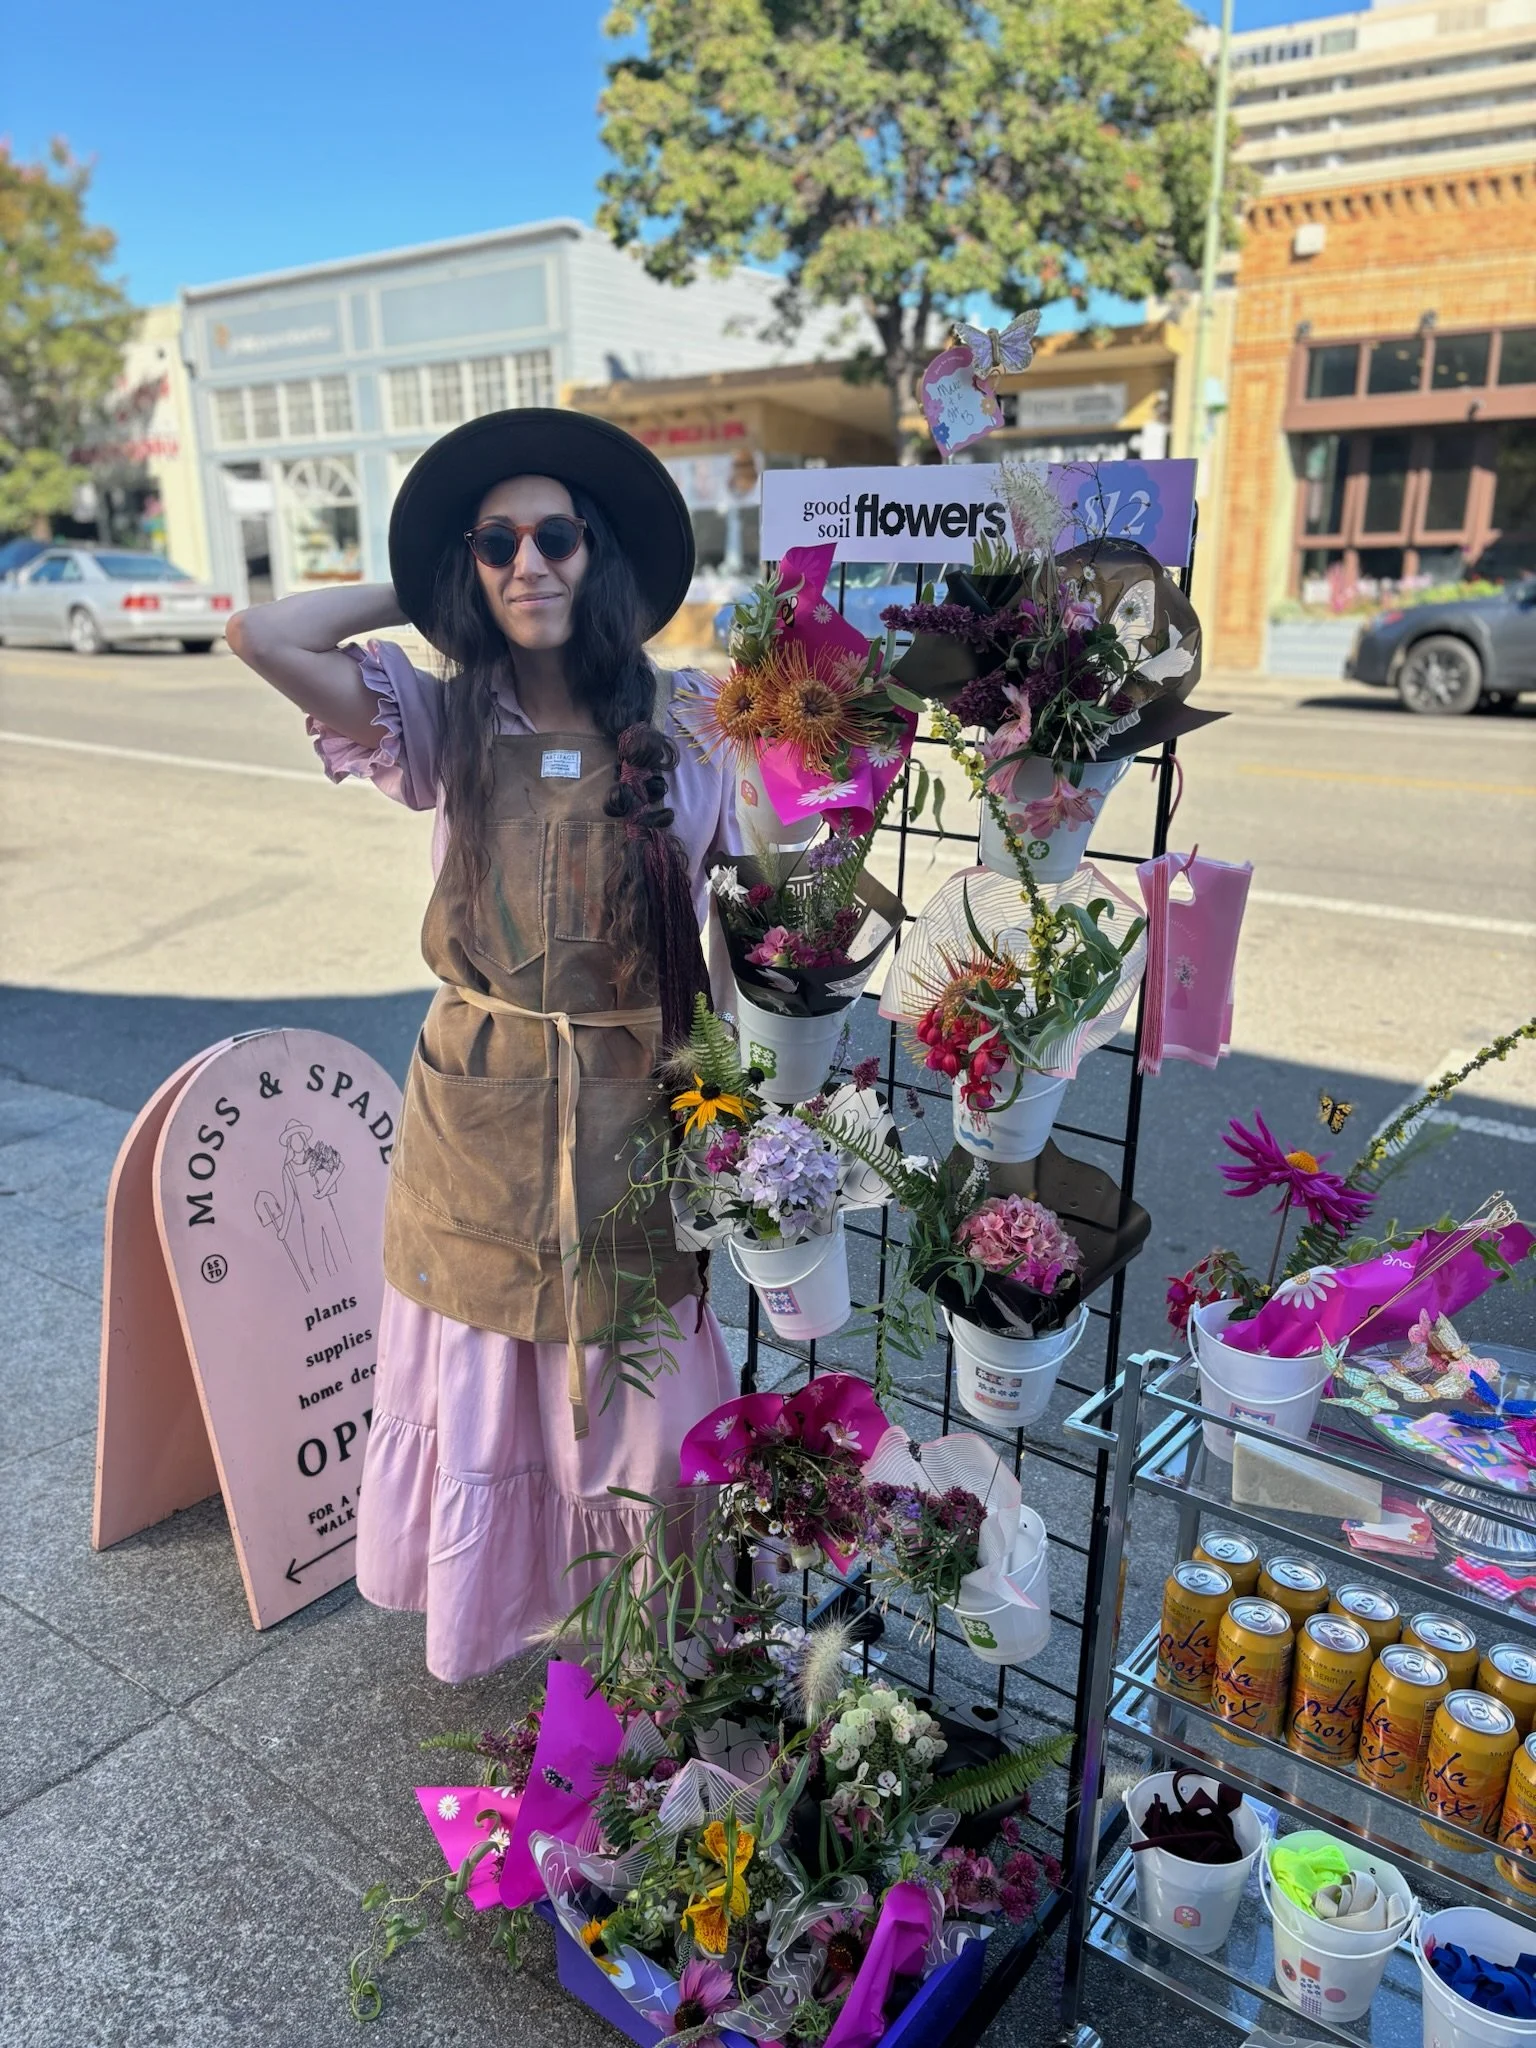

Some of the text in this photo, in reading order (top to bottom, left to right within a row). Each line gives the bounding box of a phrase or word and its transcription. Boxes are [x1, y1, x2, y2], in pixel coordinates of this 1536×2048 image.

[803, 493, 1006, 538] good flowers
[817, 518, 850, 538] soil
[1084, 490, 1151, 536] $12
[186, 1096, 240, 1227] MOSS
[259, 1071, 283, 1099] &
[304, 1296, 358, 1332] plants
[305, 1328, 373, 1368] supplies
[298, 1380, 344, 1410] home
[308, 1495, 350, 1524] FOR A
[316, 1508, 356, 1536] WALK
[1177, 1619, 1212, 1657] La
[1221, 1655, 1254, 1696] La
[1327, 1680, 1364, 1718] La
[1434, 1752, 1469, 1795] La
